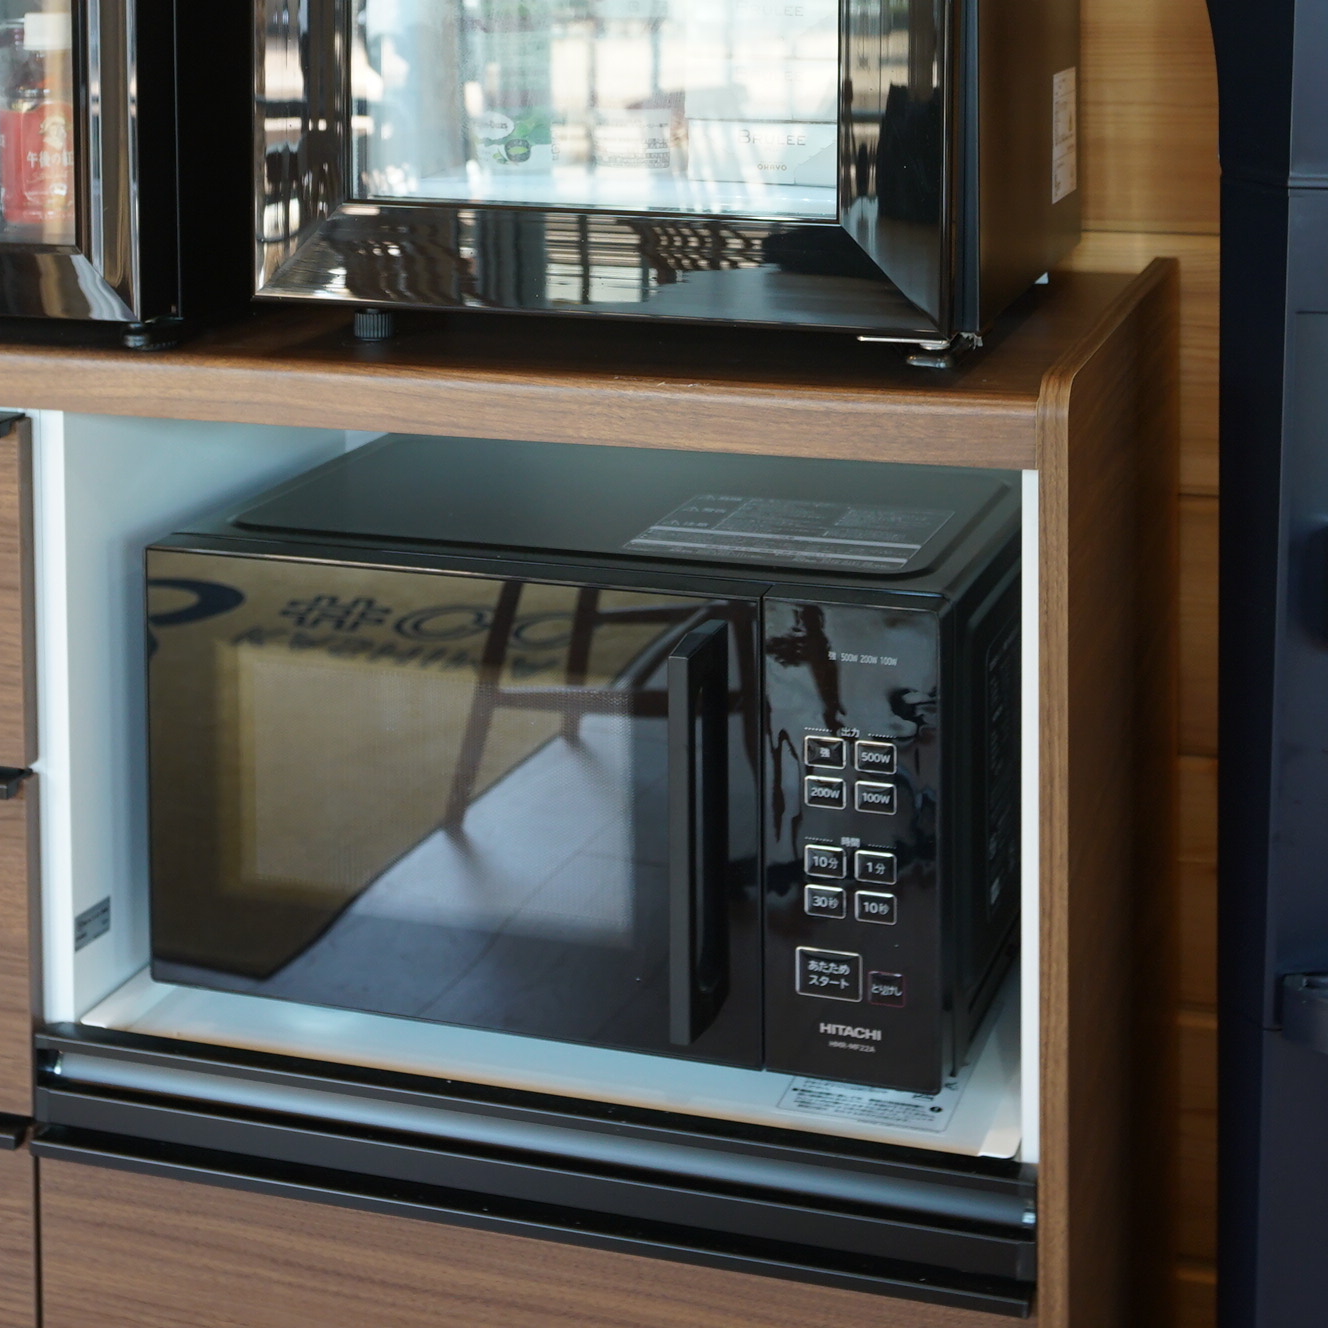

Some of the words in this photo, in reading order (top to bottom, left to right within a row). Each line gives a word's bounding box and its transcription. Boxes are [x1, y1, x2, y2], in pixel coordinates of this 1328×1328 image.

[841, 652, 858, 663] 500W
[860, 654, 878, 664] 200W
[880, 656, 898, 667] 100W
[841, 727, 860, 738] 出力
[861, 752, 891, 764] 500W
[810, 787, 840, 799] 200W
[862, 792, 891, 805] 100W
[841, 836, 860, 849] 時間
[812, 855, 838, 870] 10分
[812, 895, 839, 910] 30秒
[863, 901, 889, 916] 10秒
[807, 959, 850, 975] あたため
[808, 975, 850, 990] スタート
[819, 1022, 882, 1042] HITACHI
